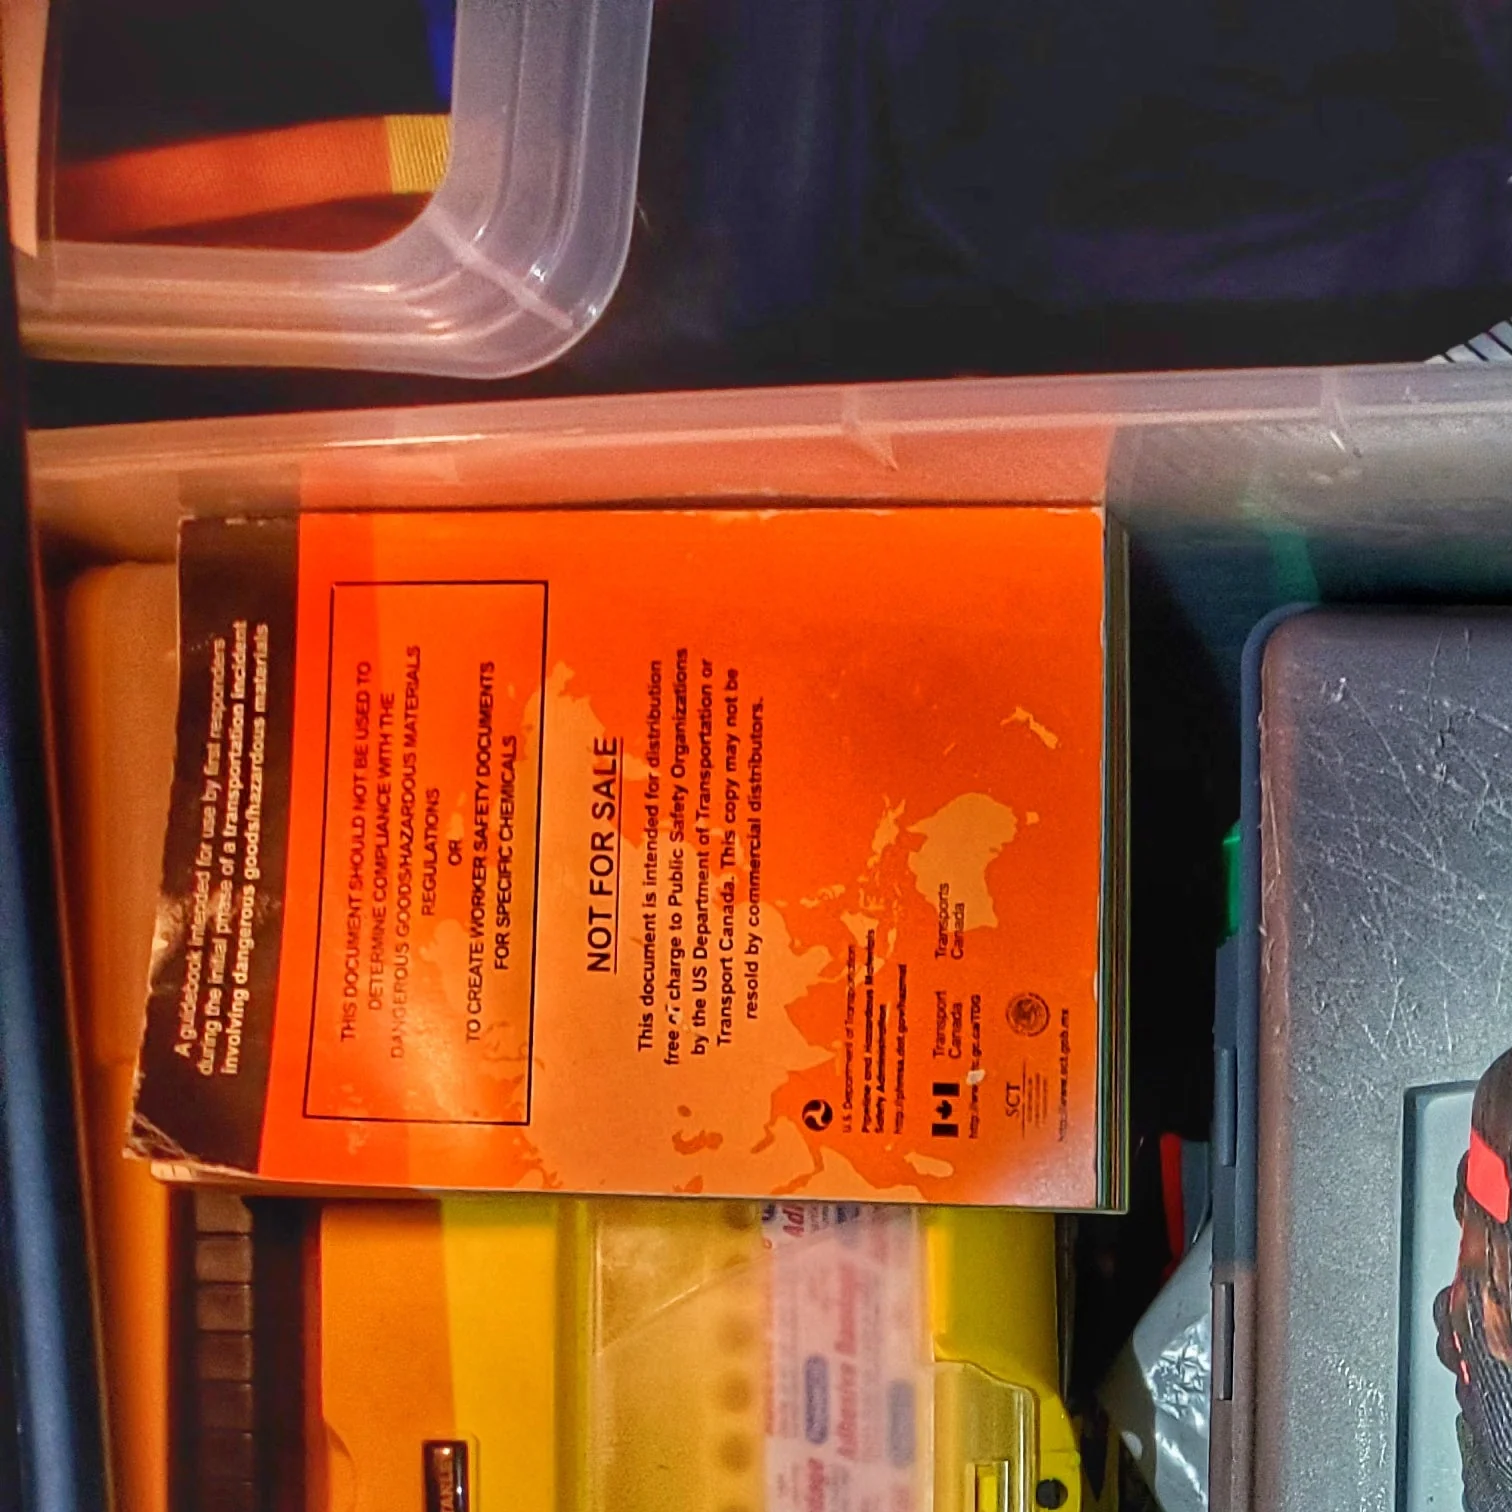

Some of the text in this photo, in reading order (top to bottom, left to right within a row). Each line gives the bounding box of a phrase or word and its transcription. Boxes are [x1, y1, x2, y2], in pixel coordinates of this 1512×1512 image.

[229, 621, 248, 699] incident
[671, 648, 689, 778] Organizations
[222, 704, 247, 837] transportation
[670, 785, 689, 843] Safety
[174, 639, 227, 1057] A guidebook intended for use by first responders
[217, 856, 236, 875] of
[222, 842, 236, 853] a
[222, 623, 269, 1074] involving dangerous goods/hazardous materials
[340, 662, 371, 1042] THIS DOCUMENT SHOULD NOT BE USED TO
[367, 693, 395, 1011] DETERMINE COMPLIANCE WITH THE
[390, 645, 421, 1058] DANGEROUS GOODS/HAZARDOUS MATERIALS
[421, 788, 440, 916] REGULATIONS
[448, 839, 462, 866] OR
[466, 661, 495, 1043] TO CREATE WORKER SAFETY DOCUMENTS
[494, 735, 517, 970] FOR SPECIFIC CHEMICALS
[587, 736, 617, 974] NOT FOR SALE
[638, 660, 663, 1052] This document is intended for distribution
[668, 849, 685, 907] Public
[691, 658, 714, 1055] by the US Department of Transportation or
[717, 668, 741, 1046] Transport Canada. This copy may not be
[744, 696, 764, 1019] resold by commercial distributors.
[207, 939, 228, 983] initial
[666, 936, 686, 1000] charge
[668, 912, 683, 931] to
[935, 883, 950, 960] Transports
[951, 902, 965, 960] Canada
[198, 1020, 222, 1076] during
[203, 987, 223, 1016] the
[664, 1030, 680, 1065] free
[861, 929, 875, 1133] Pipeline and Hazardous Materials
[932, 991, 948, 1059] Transport
[949, 1002, 963, 1059] Canada
[875, 1004, 887, 1134] Safety Administration
[1006, 1082, 1020, 1117] SCT
